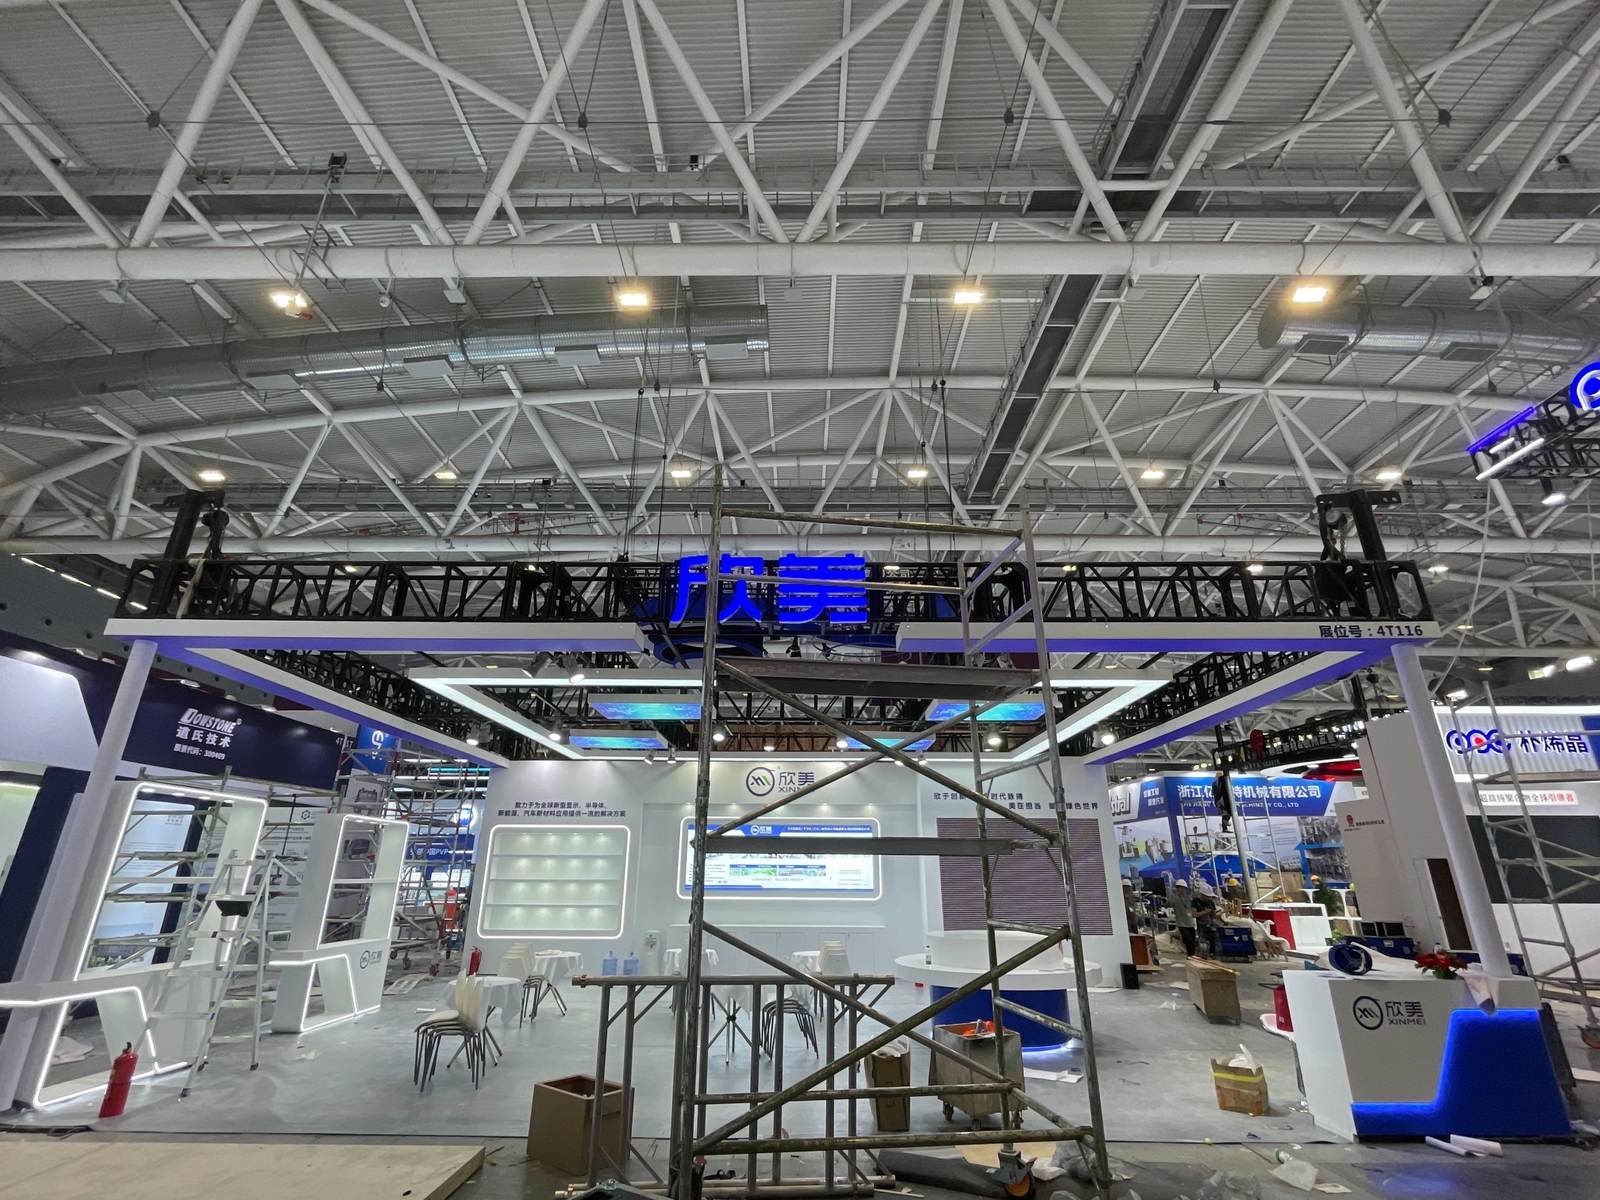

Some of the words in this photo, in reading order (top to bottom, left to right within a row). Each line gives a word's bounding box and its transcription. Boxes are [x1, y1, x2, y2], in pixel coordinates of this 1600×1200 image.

[671, 553, 867, 623] 欣美
[176, 726, 231, 748] 道氏技术
[778, 772, 815, 786] 欣美
[1177, 785, 1322, 799] 浙江亿特机械有限公司
[1385, 1001, 1424, 1017] 欣美
